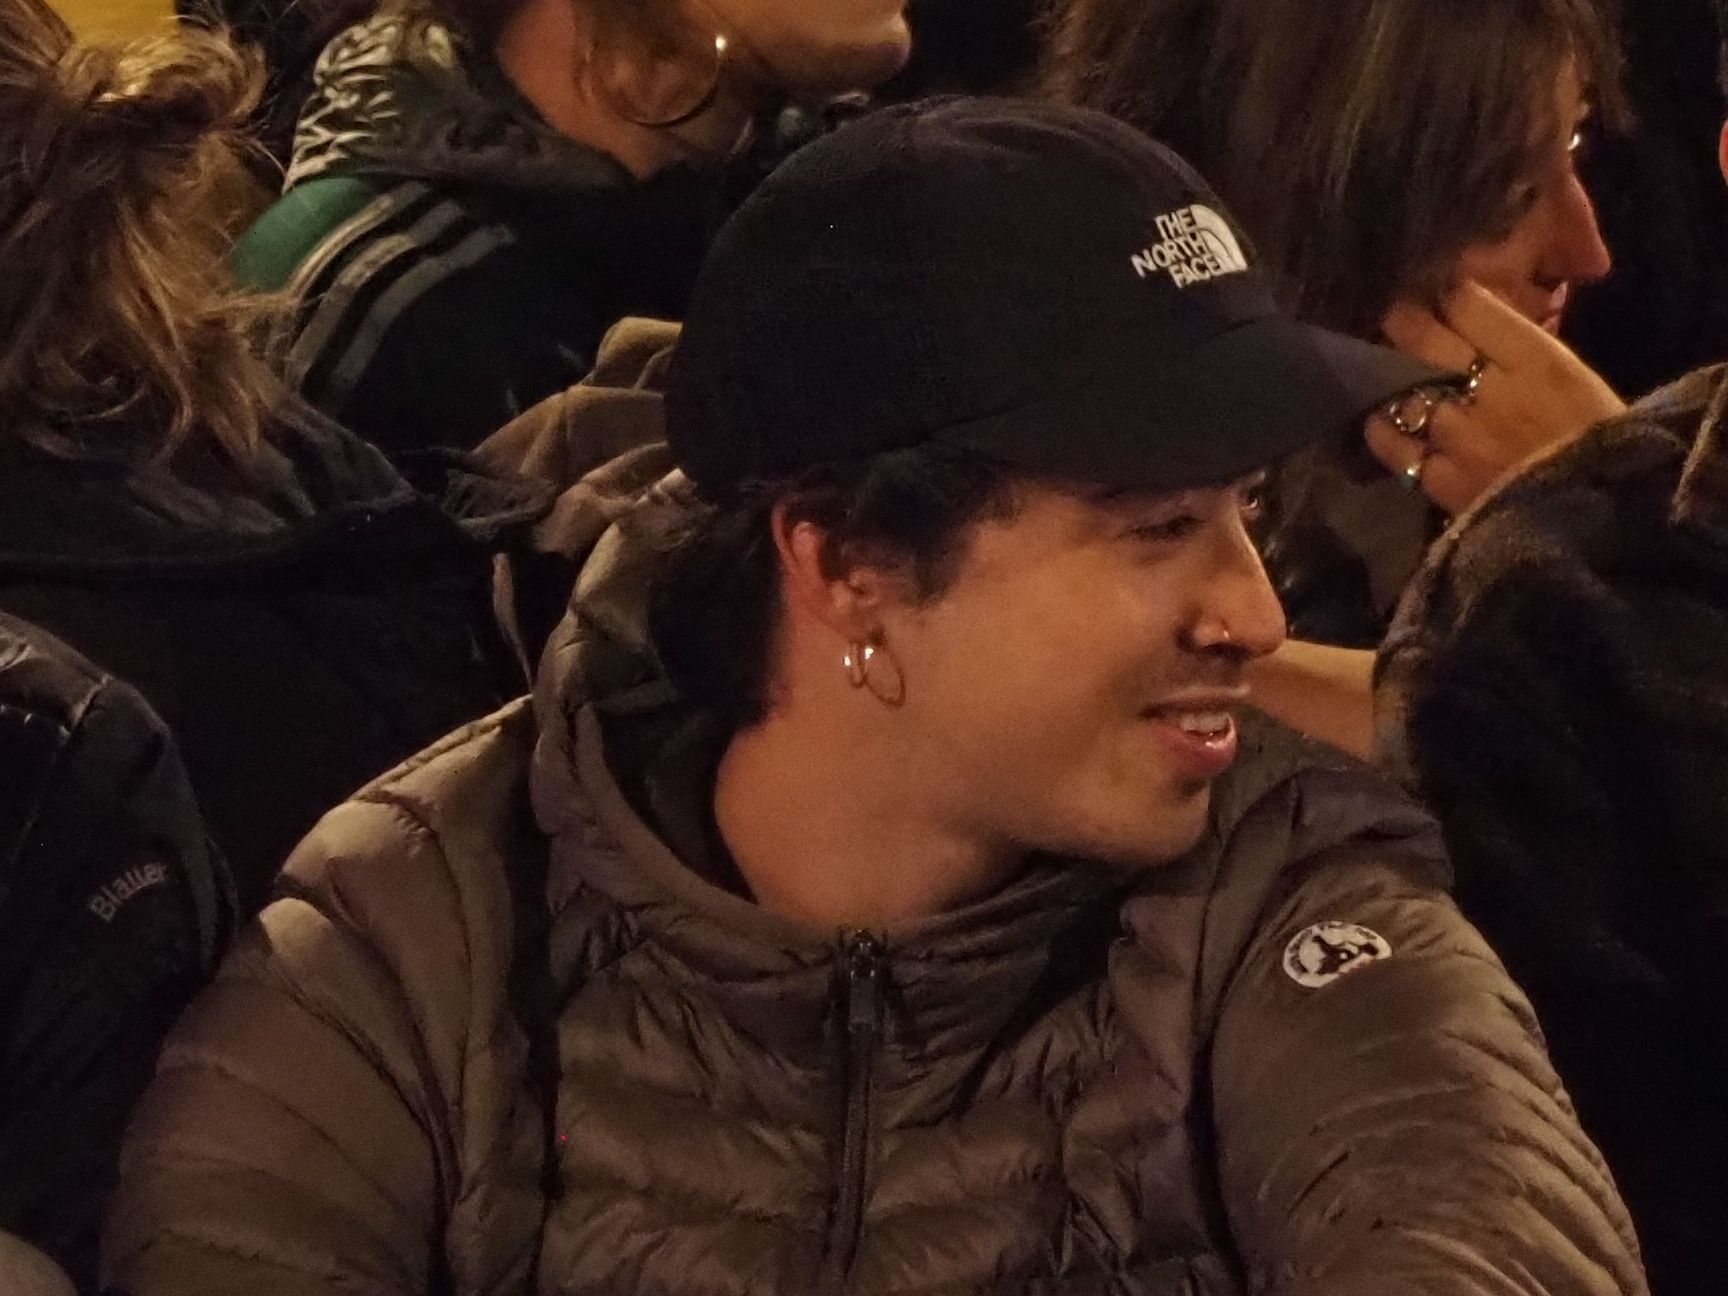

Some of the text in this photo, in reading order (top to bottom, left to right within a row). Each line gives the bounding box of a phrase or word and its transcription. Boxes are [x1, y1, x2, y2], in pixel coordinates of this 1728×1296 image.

[1154, 207, 1197, 241] THE
[1130, 230, 1211, 277] NORTH
[1168, 255, 1223, 289] FACE
[90, 863, 167, 923] Blauer
